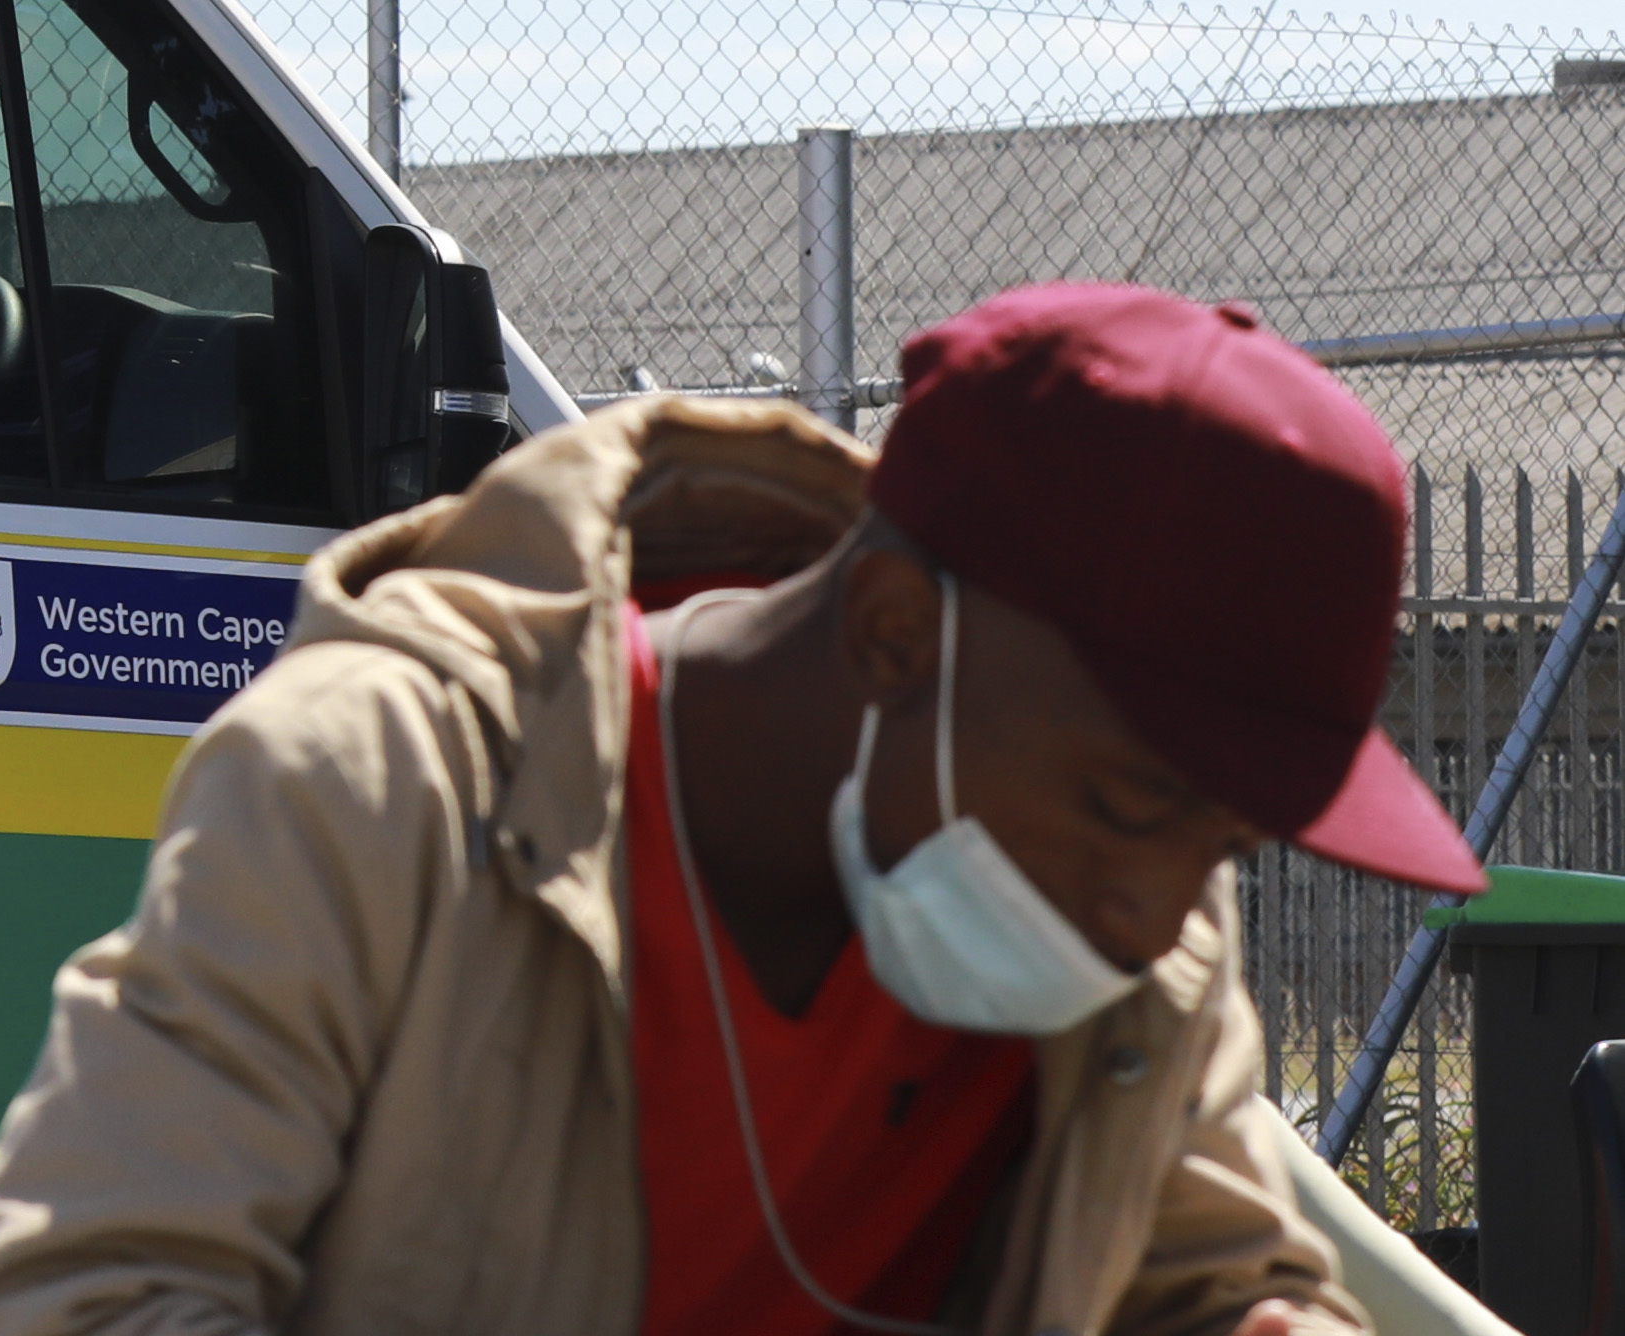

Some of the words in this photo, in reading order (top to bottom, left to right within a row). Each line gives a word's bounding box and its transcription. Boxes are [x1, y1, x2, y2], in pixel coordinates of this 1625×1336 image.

[37, 595, 185, 638] Western
[198, 608, 285, 650] Cape
[40, 644, 255, 690] Government
